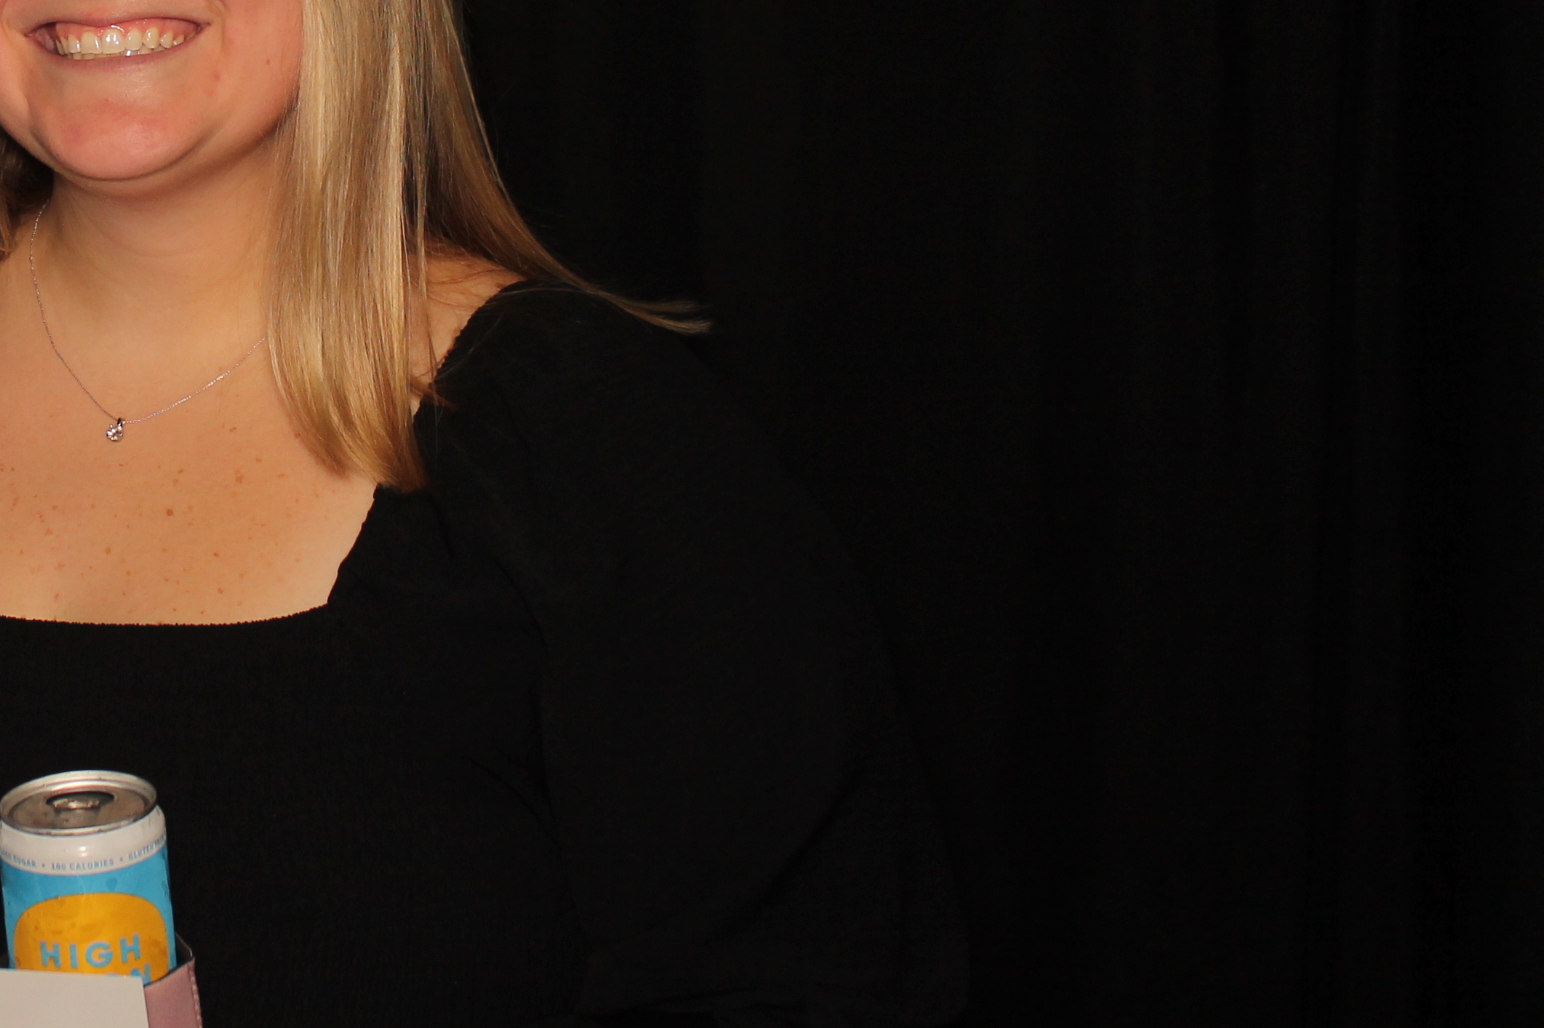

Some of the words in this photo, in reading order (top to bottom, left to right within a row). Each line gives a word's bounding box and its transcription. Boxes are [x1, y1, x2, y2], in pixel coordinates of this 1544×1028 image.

[52, 863, 66, 871] 100
[69, 858, 115, 871] CALORIES
[40, 933, 142, 968] HIGH
